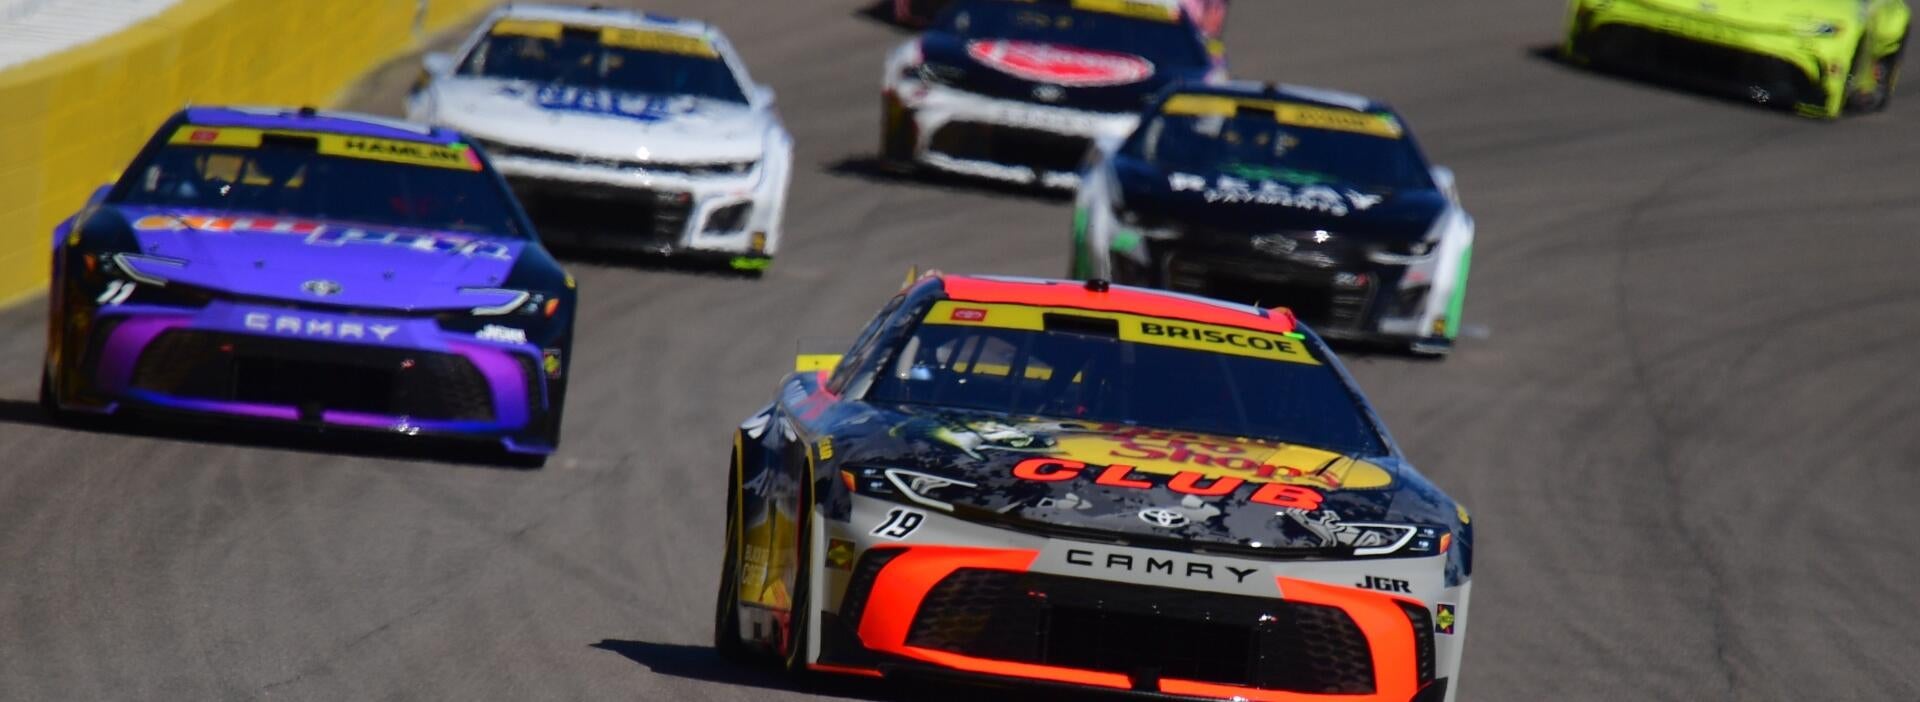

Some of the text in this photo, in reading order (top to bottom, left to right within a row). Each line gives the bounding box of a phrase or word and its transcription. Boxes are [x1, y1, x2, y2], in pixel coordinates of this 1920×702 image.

[96, 280, 136, 306] 11
[244, 312, 400, 341] CAMRY
[1140, 321, 1298, 355] BRISCOE
[1011, 456, 1325, 512] CLUB
[871, 507, 927, 540] 19
[1066, 548, 1259, 584] CAMRY
[1355, 575, 1413, 594] JGR
